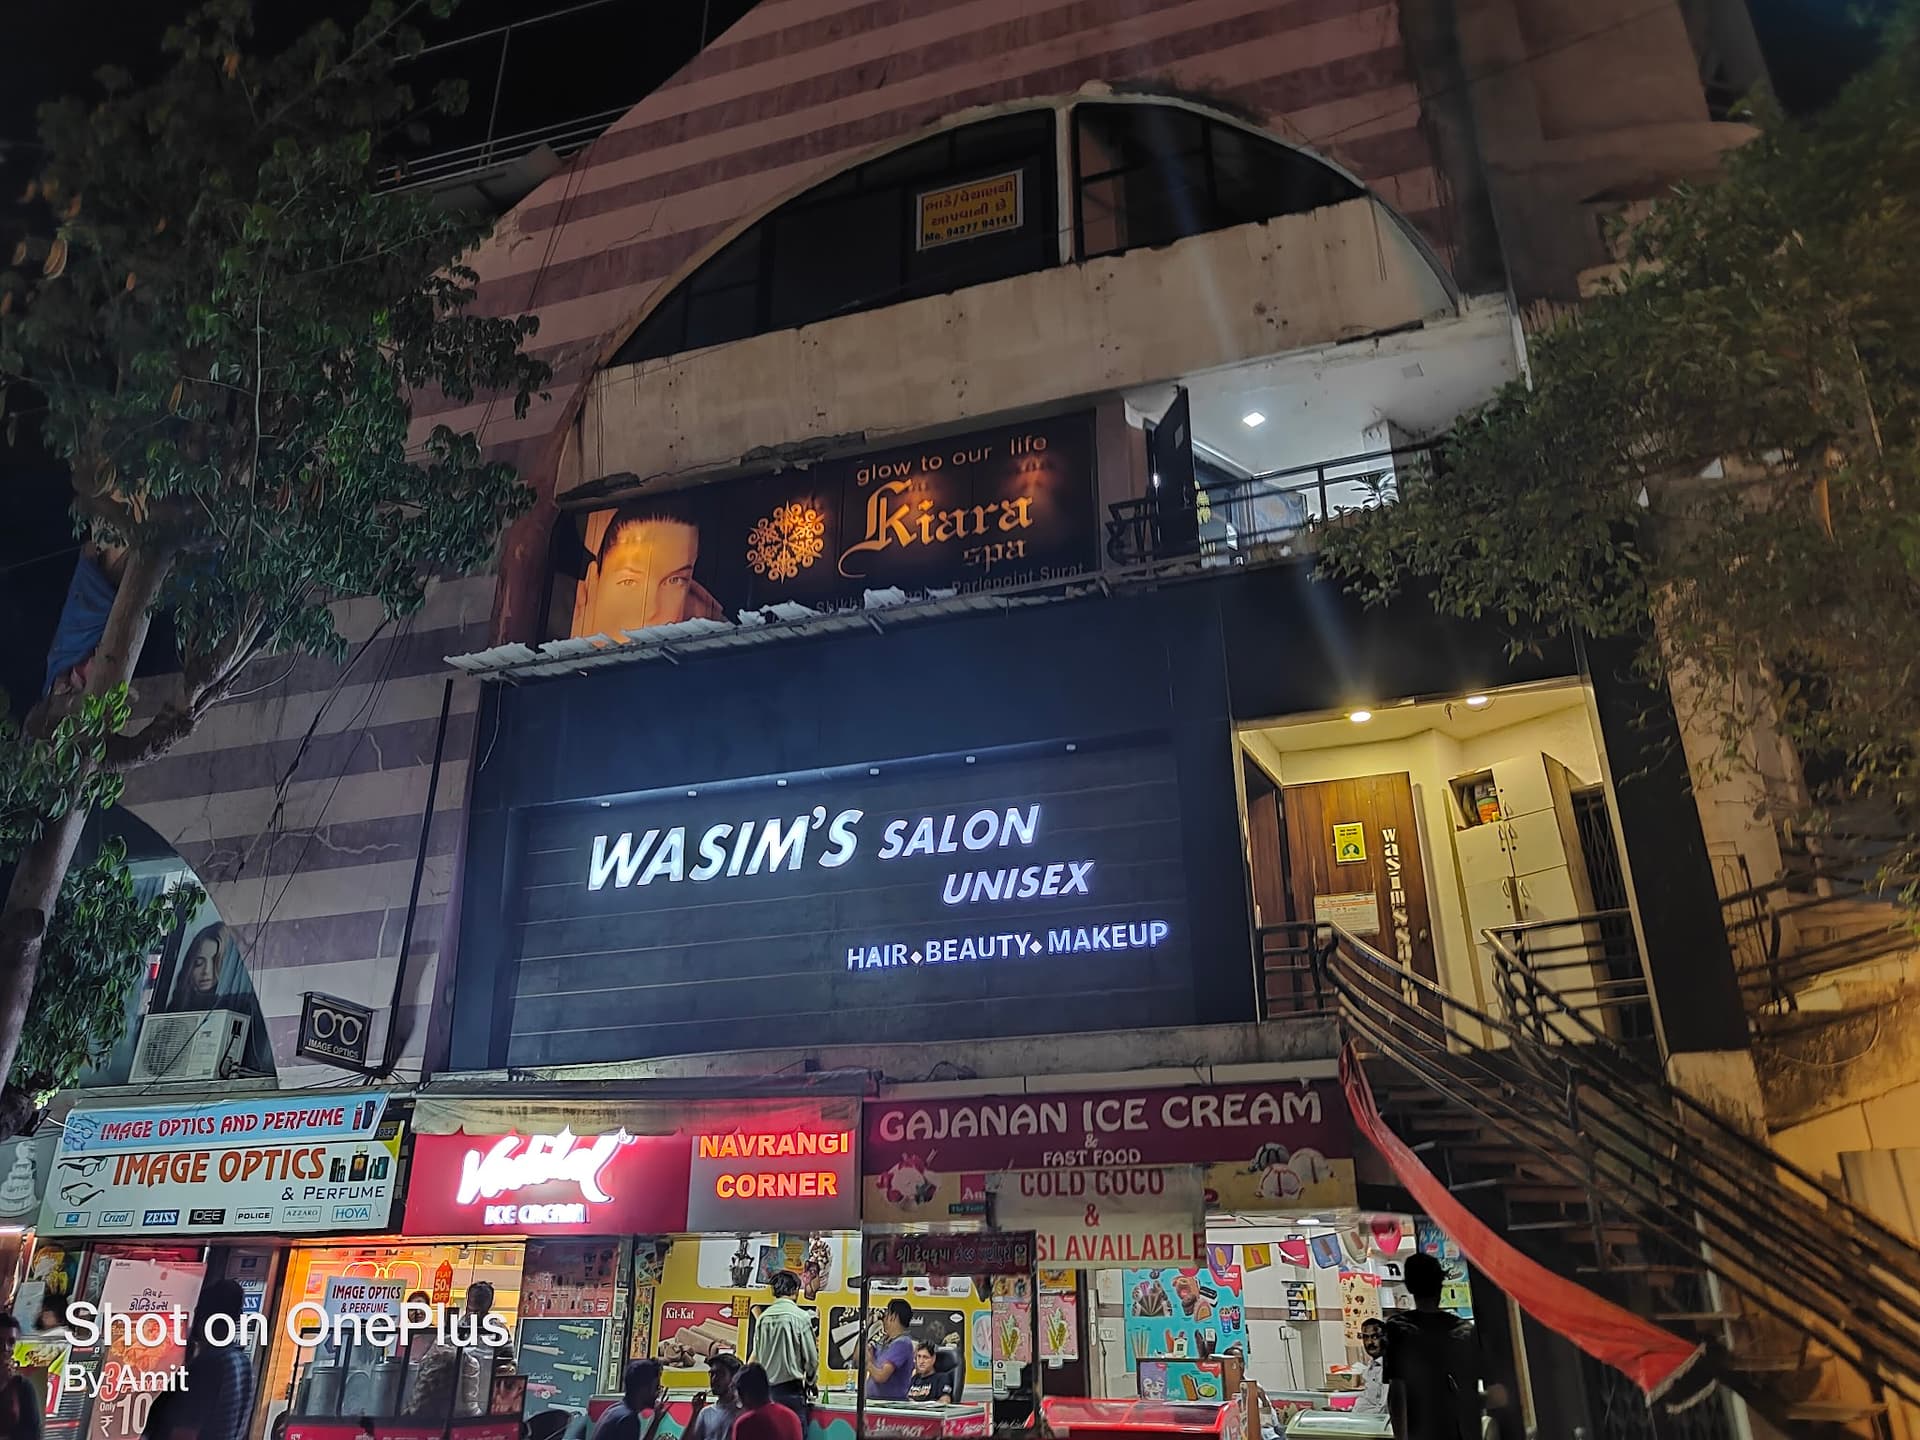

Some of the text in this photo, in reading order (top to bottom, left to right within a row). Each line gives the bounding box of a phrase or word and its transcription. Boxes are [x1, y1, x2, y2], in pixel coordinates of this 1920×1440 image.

[856, 435, 1047, 486] glow to our life
[848, 478, 1033, 562] Kiara
[963, 539, 1027, 573] spa
[1040, 561, 1084, 582] Surat
[586, 803, 1041, 892] WASIM'S SALON
[941, 860, 1095, 905] UNISEX
[846, 921, 1169, 972] HAIR BEAUTY MAKEUP
[308, 1038, 359, 1060] IMAGE OPTICS
[100, 1107, 345, 1142] IMAGE OPTICS AND PERFUME
[879, 1091, 1324, 1143] GAJANAN ICE CREAM
[699, 1130, 850, 1158] NAVRANGI
[1085, 1133, 1099, 1149] &
[112, 1148, 326, 1188] IMAGE OPTICS
[1043, 1148, 1142, 1167] FAST FOOD
[281, 1186, 386, 1201] & PERFUME
[716, 1172, 839, 1199] CORNER
[1020, 1168, 1165, 1198] COLD COCO
[144, 1211, 178, 1225] ZEISS
[237, 1212, 270, 1221] POLICE
[335, 1207, 369, 1220] HOYA
[1085, 1203, 1100, 1228] &
[1065, 1231, 1206, 1262] AVAILABLE
[332, 1284, 402, 1300] IMAGE OPTICS
[433, 1292, 448, 1301] OFF
[340, 1302, 389, 1313] & PERFUME
[99, 1402, 116, 1413] Only
